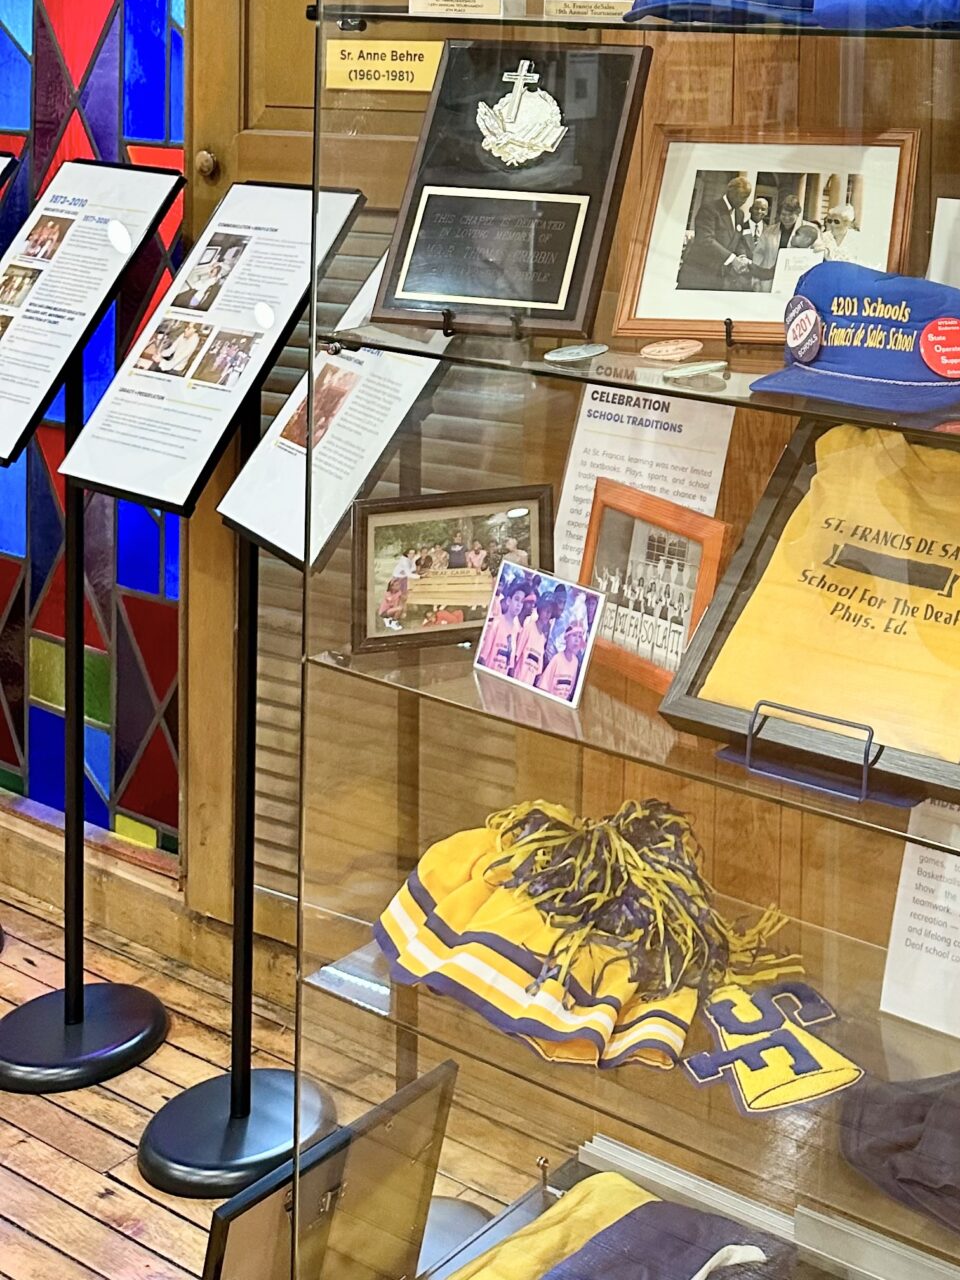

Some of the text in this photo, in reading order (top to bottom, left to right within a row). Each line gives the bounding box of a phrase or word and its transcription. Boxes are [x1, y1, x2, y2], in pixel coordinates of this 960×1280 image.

[340, 50, 424, 63] Sr. Anne Behre
[348, 69, 414, 84] (1960-1981)
[786, 301, 804, 324] SUPPORT
[831, 297, 911, 323] 4201 Schools
[791, 314, 812, 341] 4201
[828, 322, 917, 352] Francis de Sales School
[798, 333, 818, 357] SCHOOLS
[591, 390, 670, 413] CELEBRATION
[587, 409, 683, 433] SCHOOL TRADITIONS
[673, 489, 696, 500] chance
[821, 517, 844, 534] ST.
[850, 524, 914, 550] FRANCIS
[916, 538, 934, 556] DE
[798, 569, 960, 626] School For The Deaf
[830, 602, 907, 636] Phys. Ed.
[910, 911, 948, 928] recreation
[908, 925, 922, 936] and
[924, 928, 951, 947] lifelong
[904, 938, 950, 959] Deaf school
